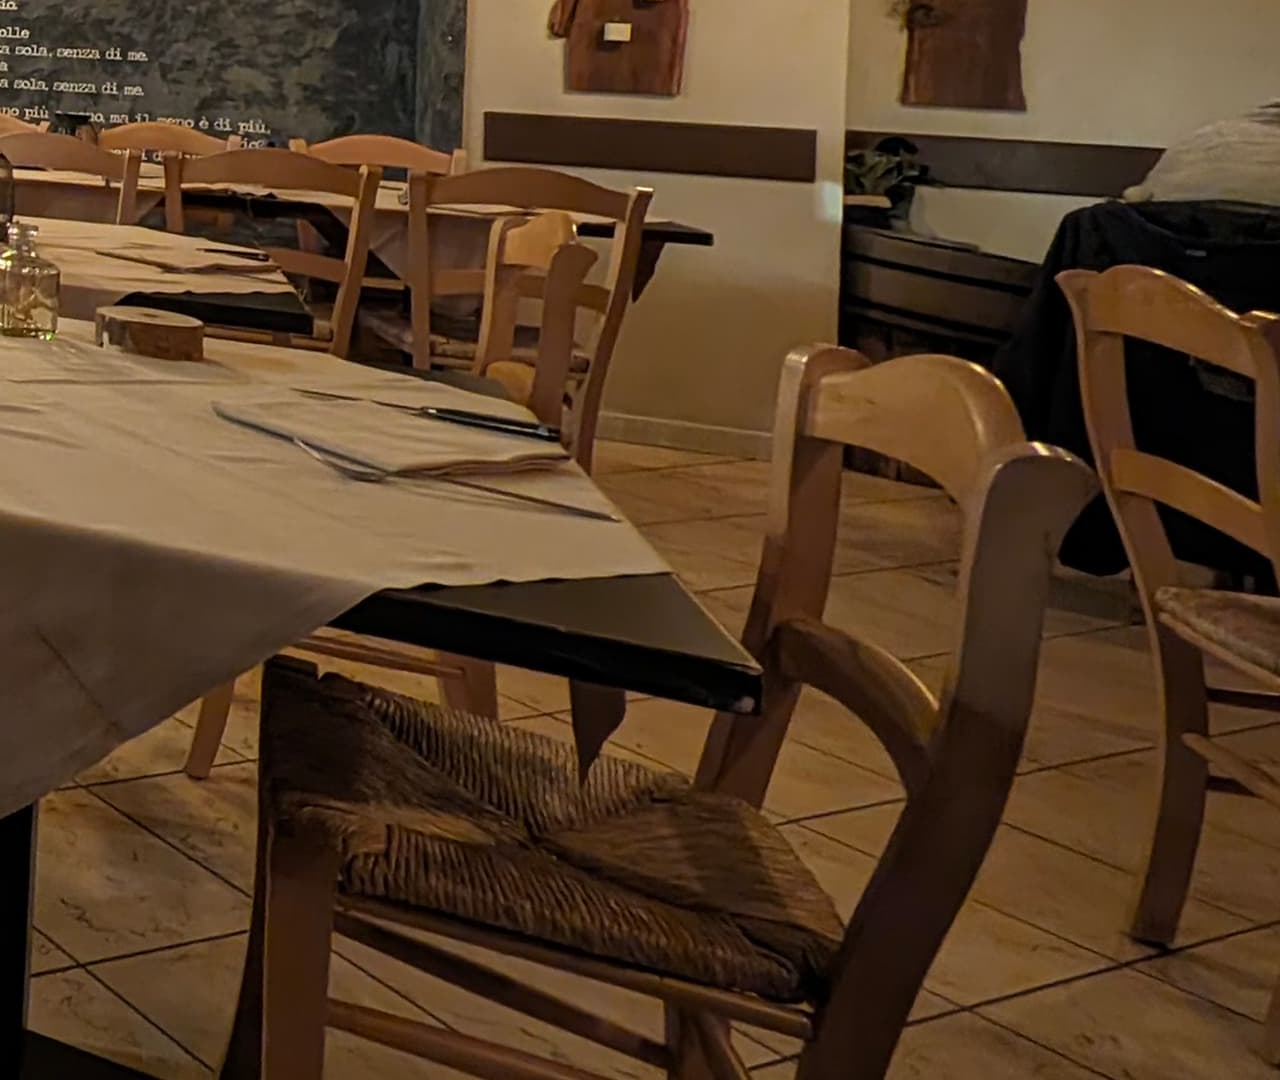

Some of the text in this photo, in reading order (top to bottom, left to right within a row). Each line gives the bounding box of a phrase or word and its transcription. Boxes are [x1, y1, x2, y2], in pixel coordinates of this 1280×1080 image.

[57, 48, 100, 59] senza
[106, 48, 122, 60] di
[53, 82, 96, 92] senza
[102, 82, 118, 94] di
[24, 106, 50, 120] più
[214, 116, 232, 131] di
